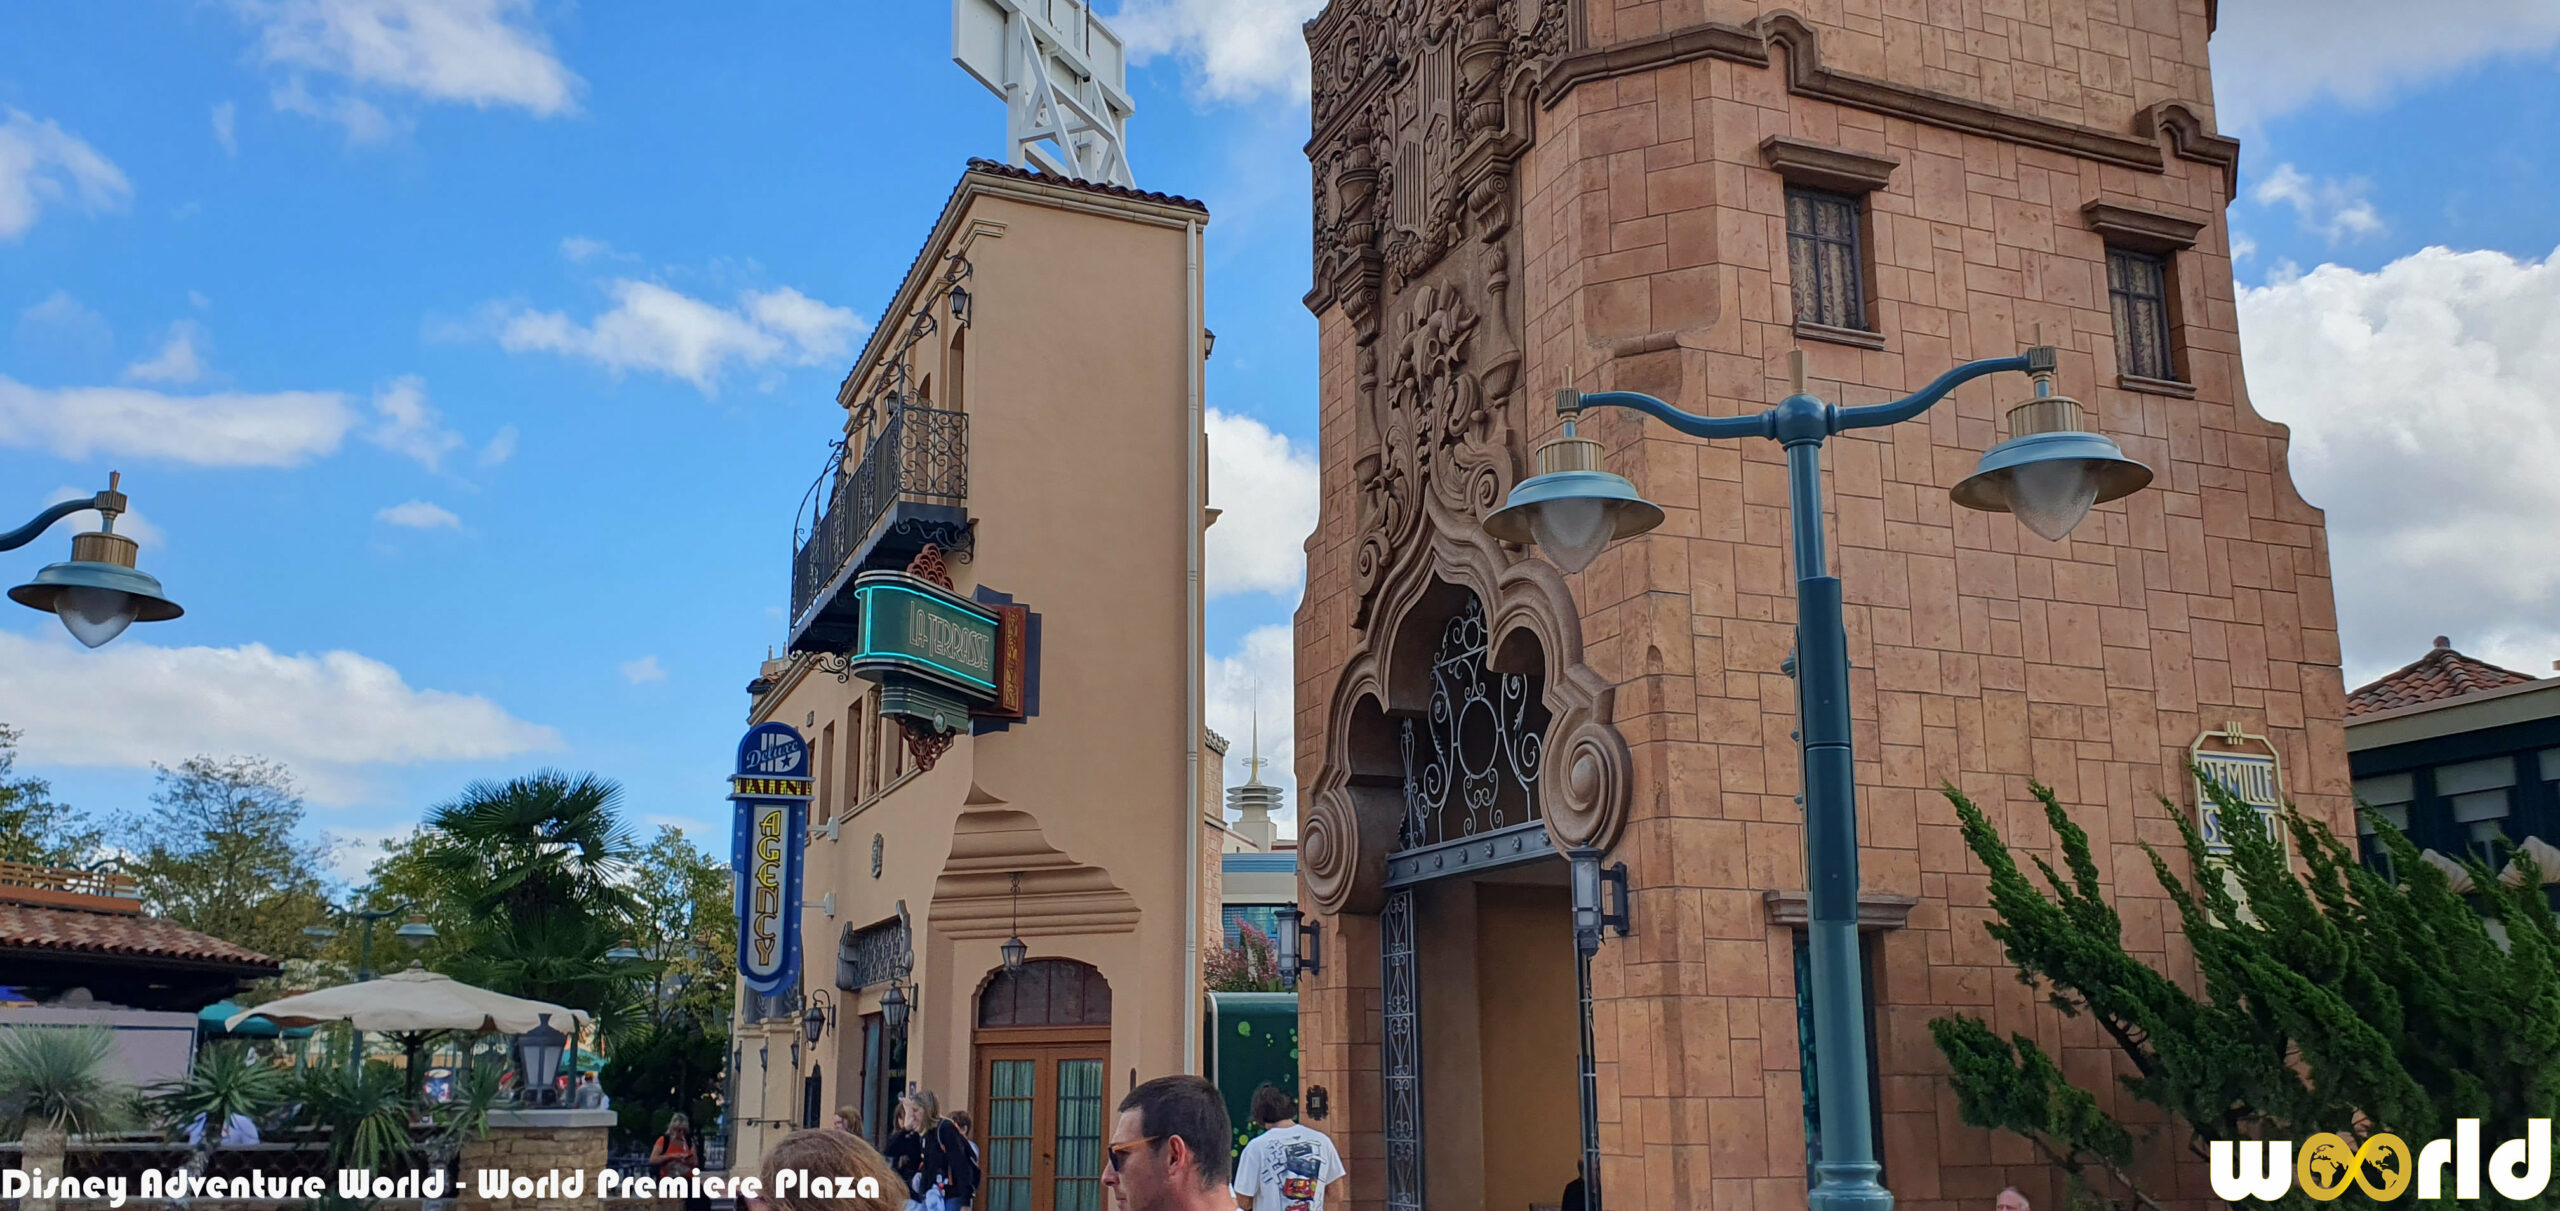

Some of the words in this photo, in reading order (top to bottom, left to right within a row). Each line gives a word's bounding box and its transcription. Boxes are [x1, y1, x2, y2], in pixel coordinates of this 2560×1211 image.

[909, 600, 928, 649] LA
[928, 613, 990, 672] TERRASSE
[746, 741, 799, 770] Deluxe
[735, 779, 812, 796] TALENT
[754, 810, 782, 966] AGENCY
